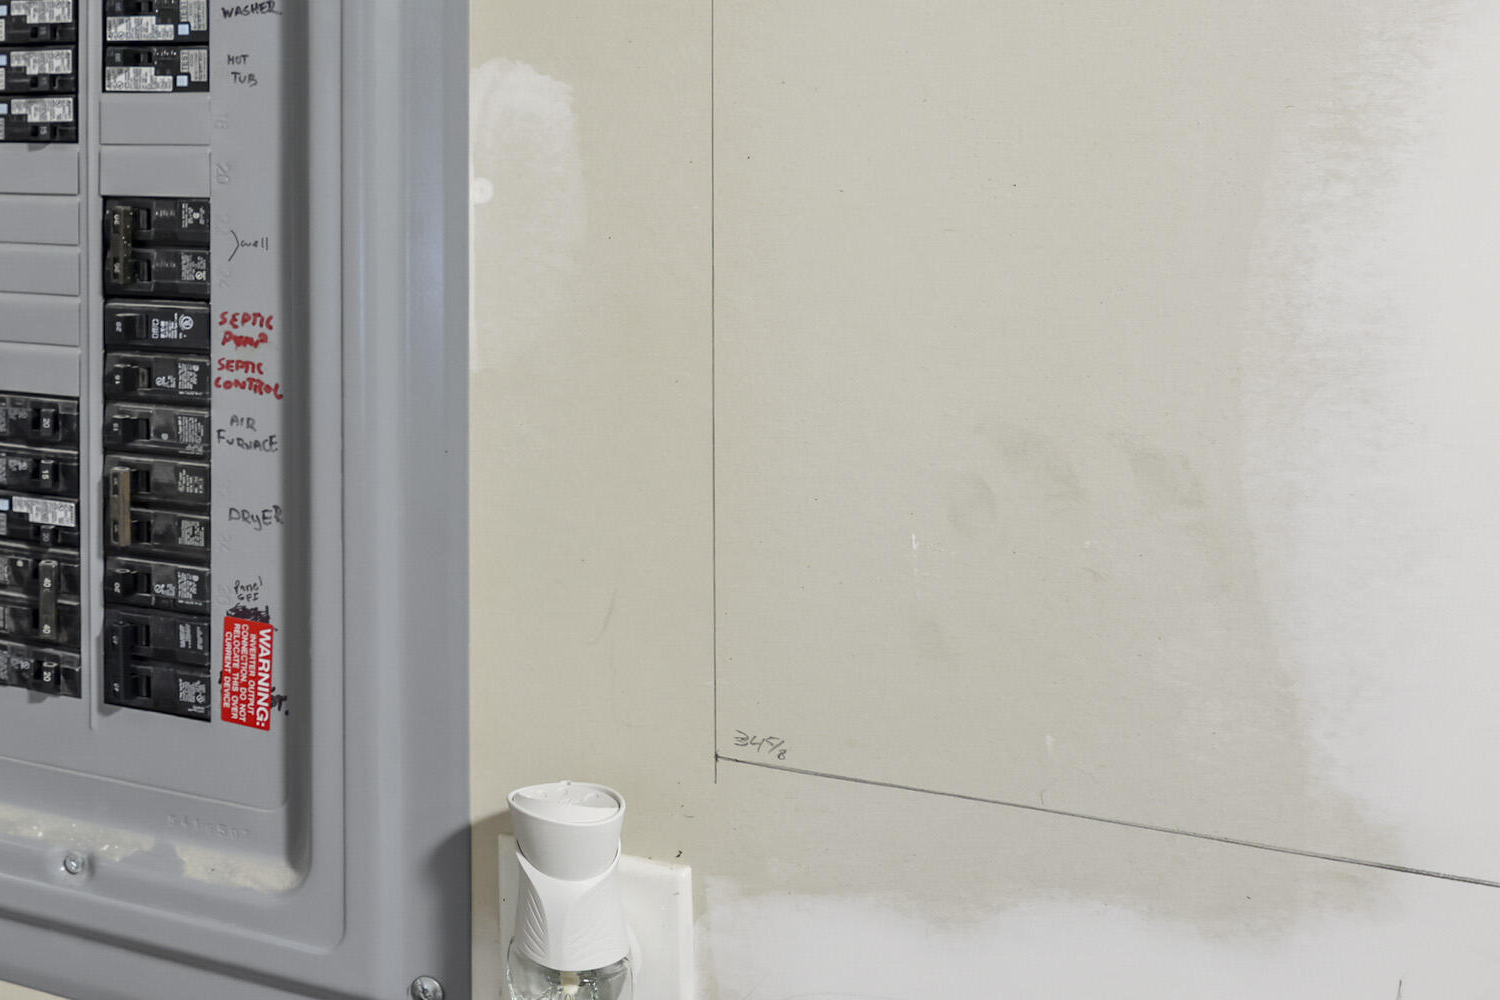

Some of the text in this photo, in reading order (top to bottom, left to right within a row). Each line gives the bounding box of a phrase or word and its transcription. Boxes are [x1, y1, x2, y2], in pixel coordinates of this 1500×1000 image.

[221, 0, 282, 19] WASHER
[227, 54, 249, 65] HOT
[230, 71, 258, 87] TUB
[218, 311, 274, 330] SEPTIC
[217, 357, 264, 375] SEPTIC
[214, 376, 283, 400] CONTROL
[229, 414, 258, 432] AIR
[216, 429, 279, 453] FURNACE
[233, 623, 241, 669] RELOCATE
[223, 631, 233, 709] CURRENT DEVICE
[246, 634, 257, 716] INVERTER OUTPUT
[256, 628, 272, 727] WARNING:
[240, 685, 247, 701] DO
[230, 695, 238, 720] OVER
[238, 702, 247, 723] NOT
